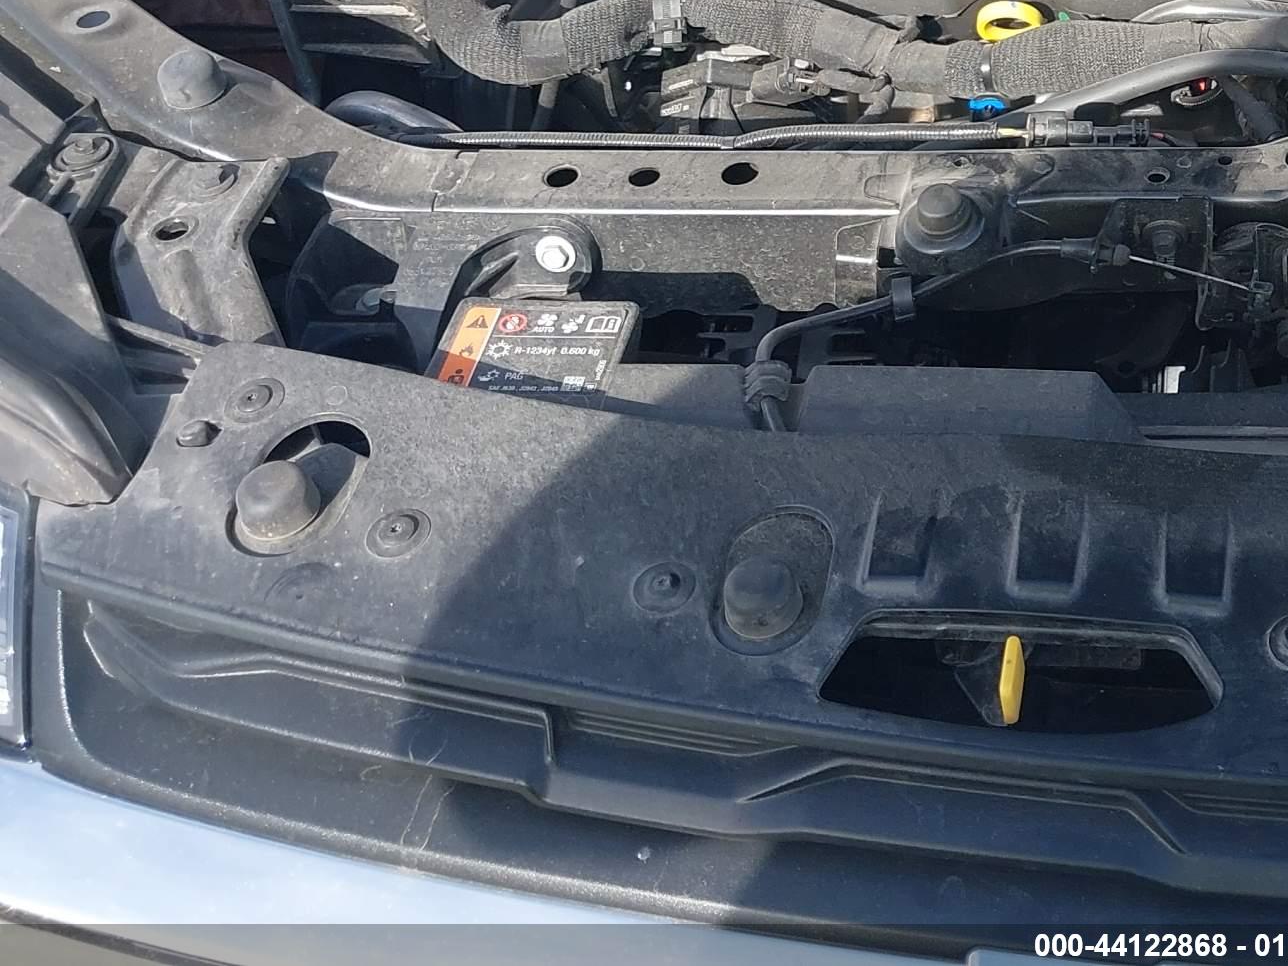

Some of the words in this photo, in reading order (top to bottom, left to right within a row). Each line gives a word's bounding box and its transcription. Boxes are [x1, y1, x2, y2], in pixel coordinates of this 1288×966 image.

[514, 346, 557, 356] R-1234yf
[588, 346, 601, 356] kg
[504, 372, 524, 380] PAG
